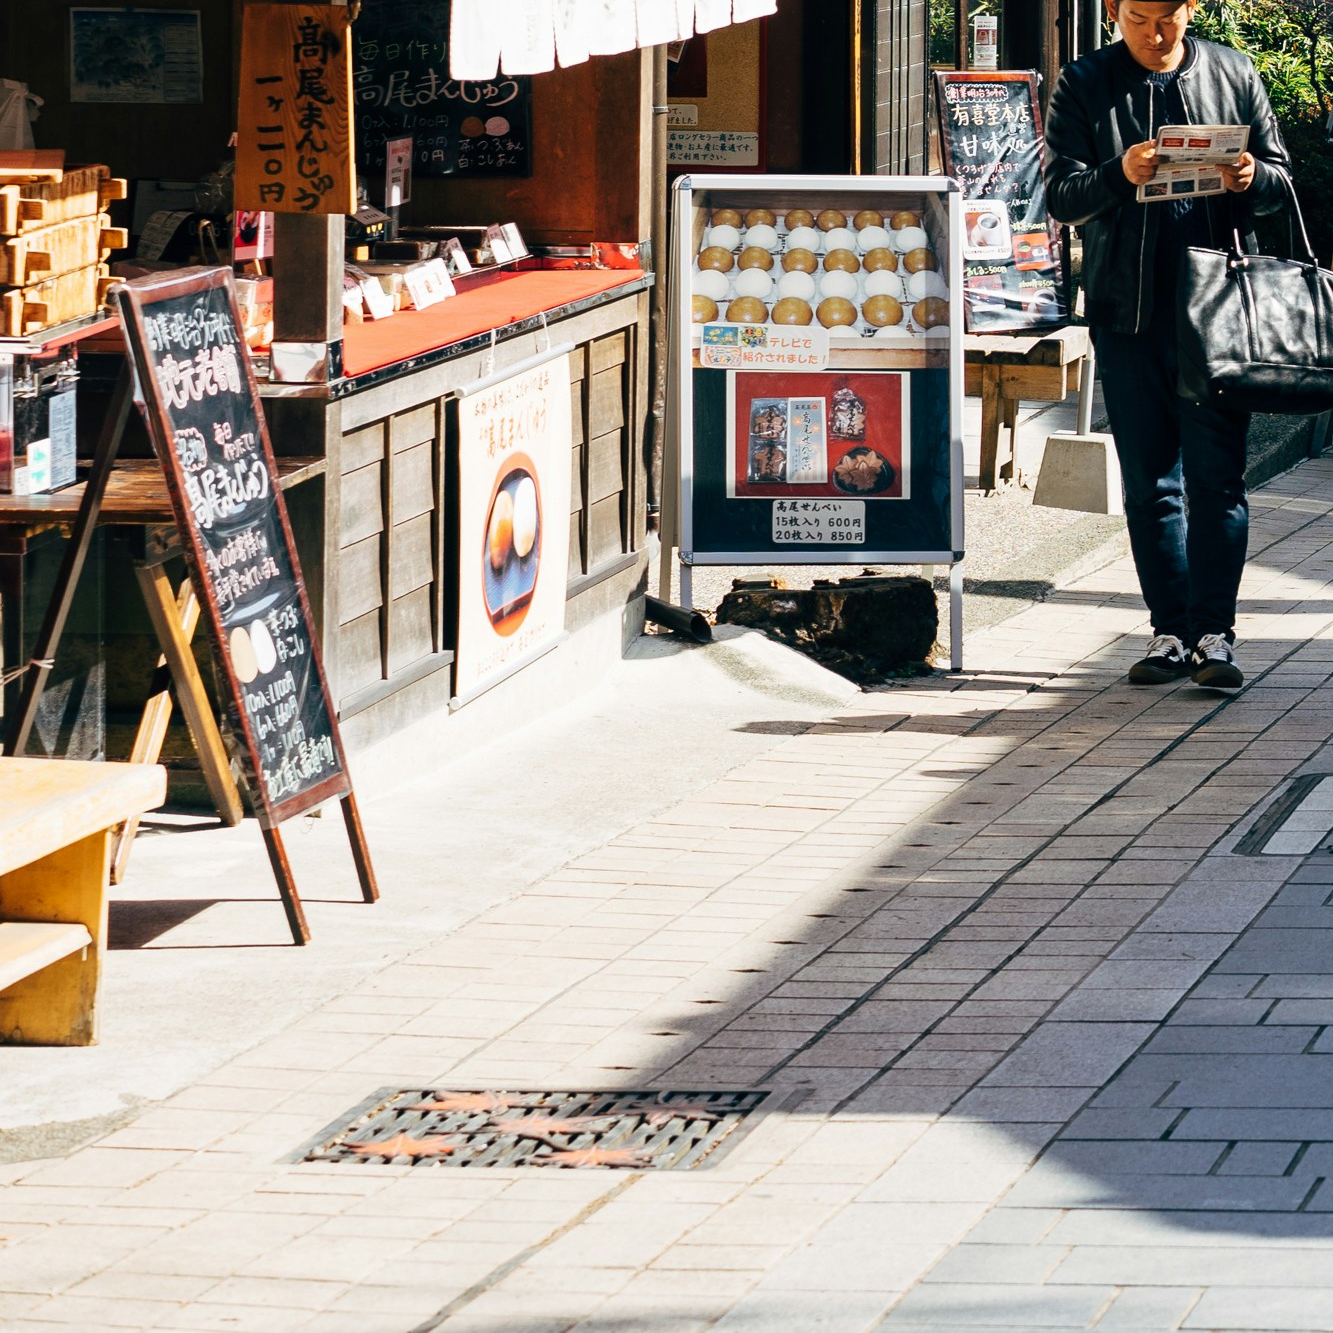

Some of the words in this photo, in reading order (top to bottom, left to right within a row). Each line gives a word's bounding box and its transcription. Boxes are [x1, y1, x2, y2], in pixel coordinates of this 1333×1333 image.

[293, 17, 336, 212] 高尾まんじゅう
[951, 102, 1030, 126] 有喜堂本店
[769, 337, 813, 349] テレビで
[743, 352, 827, 365] 紹介されました!
[776, 501, 843, 513] 高尾せんべい
[776, 516, 821, 528] 15枚入り
[828, 517, 862, 528] 600円
[775, 531, 823, 542] 20枚入り
[830, 531, 863, 542] 850円
